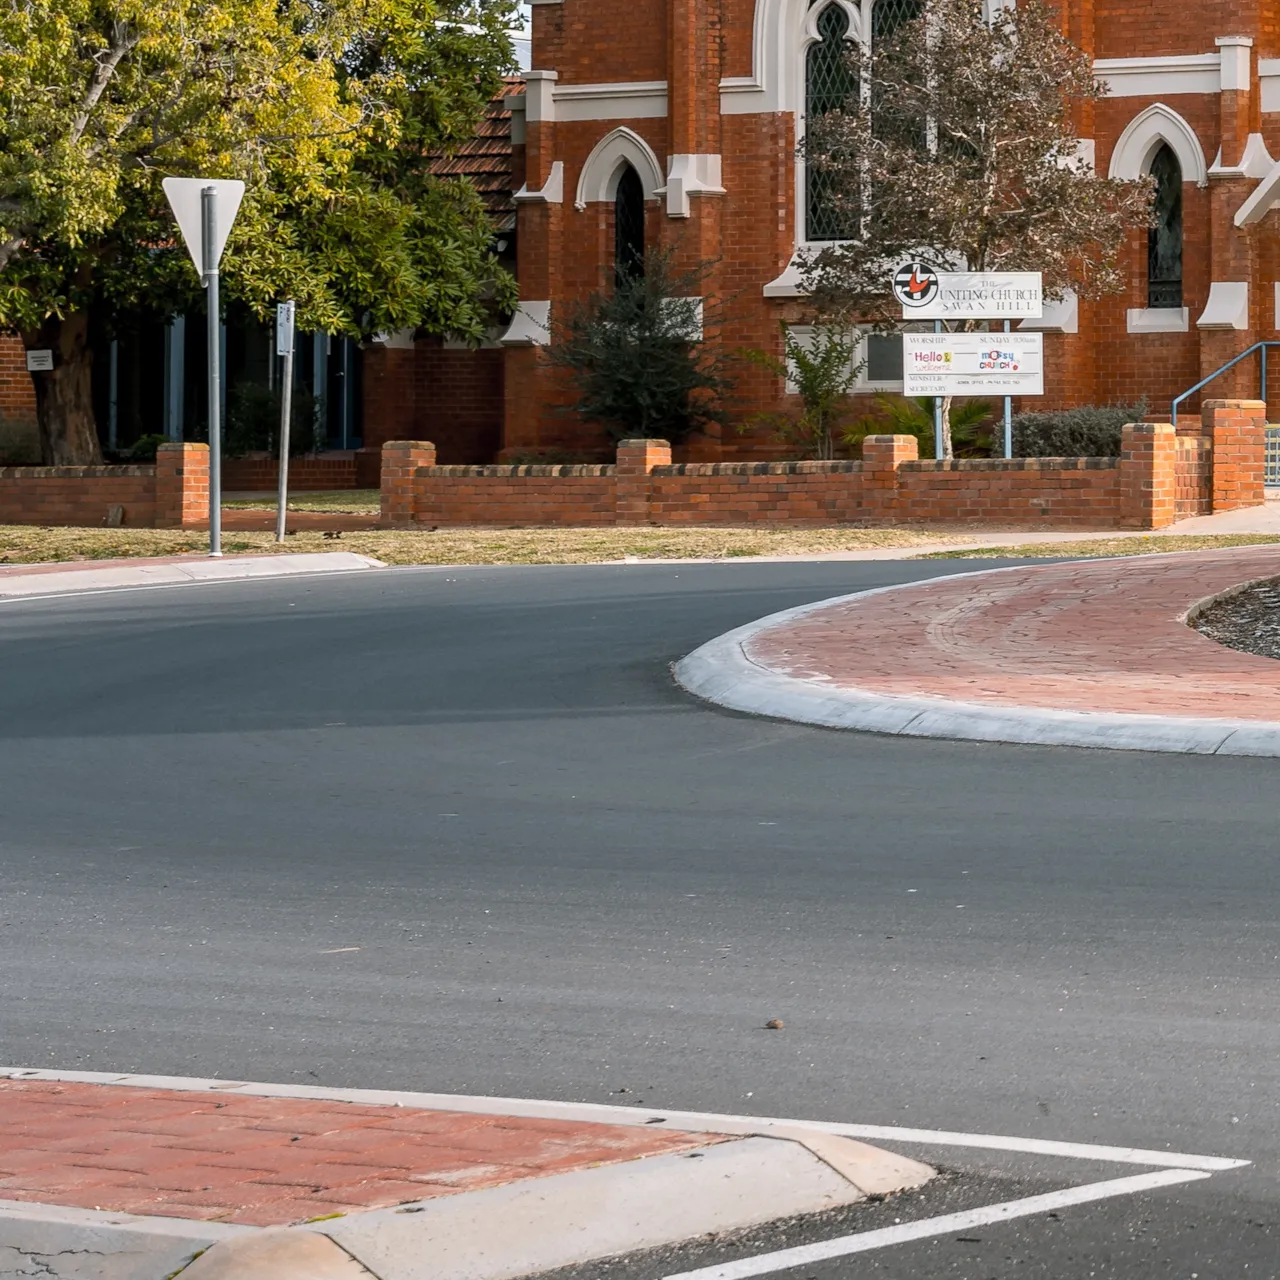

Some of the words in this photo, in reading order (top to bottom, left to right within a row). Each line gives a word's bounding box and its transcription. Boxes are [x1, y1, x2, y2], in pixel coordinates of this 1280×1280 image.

[940, 289, 988, 300] UNITING
[991, 289, 1037, 300] CHURCH
[942, 301, 986, 311] SWAN
[996, 301, 1034, 310] HILL
[980, 336, 1010, 344] SUNDAY
[914, 351, 943, 362] Hello
[980, 361, 1010, 369] CHURCH
